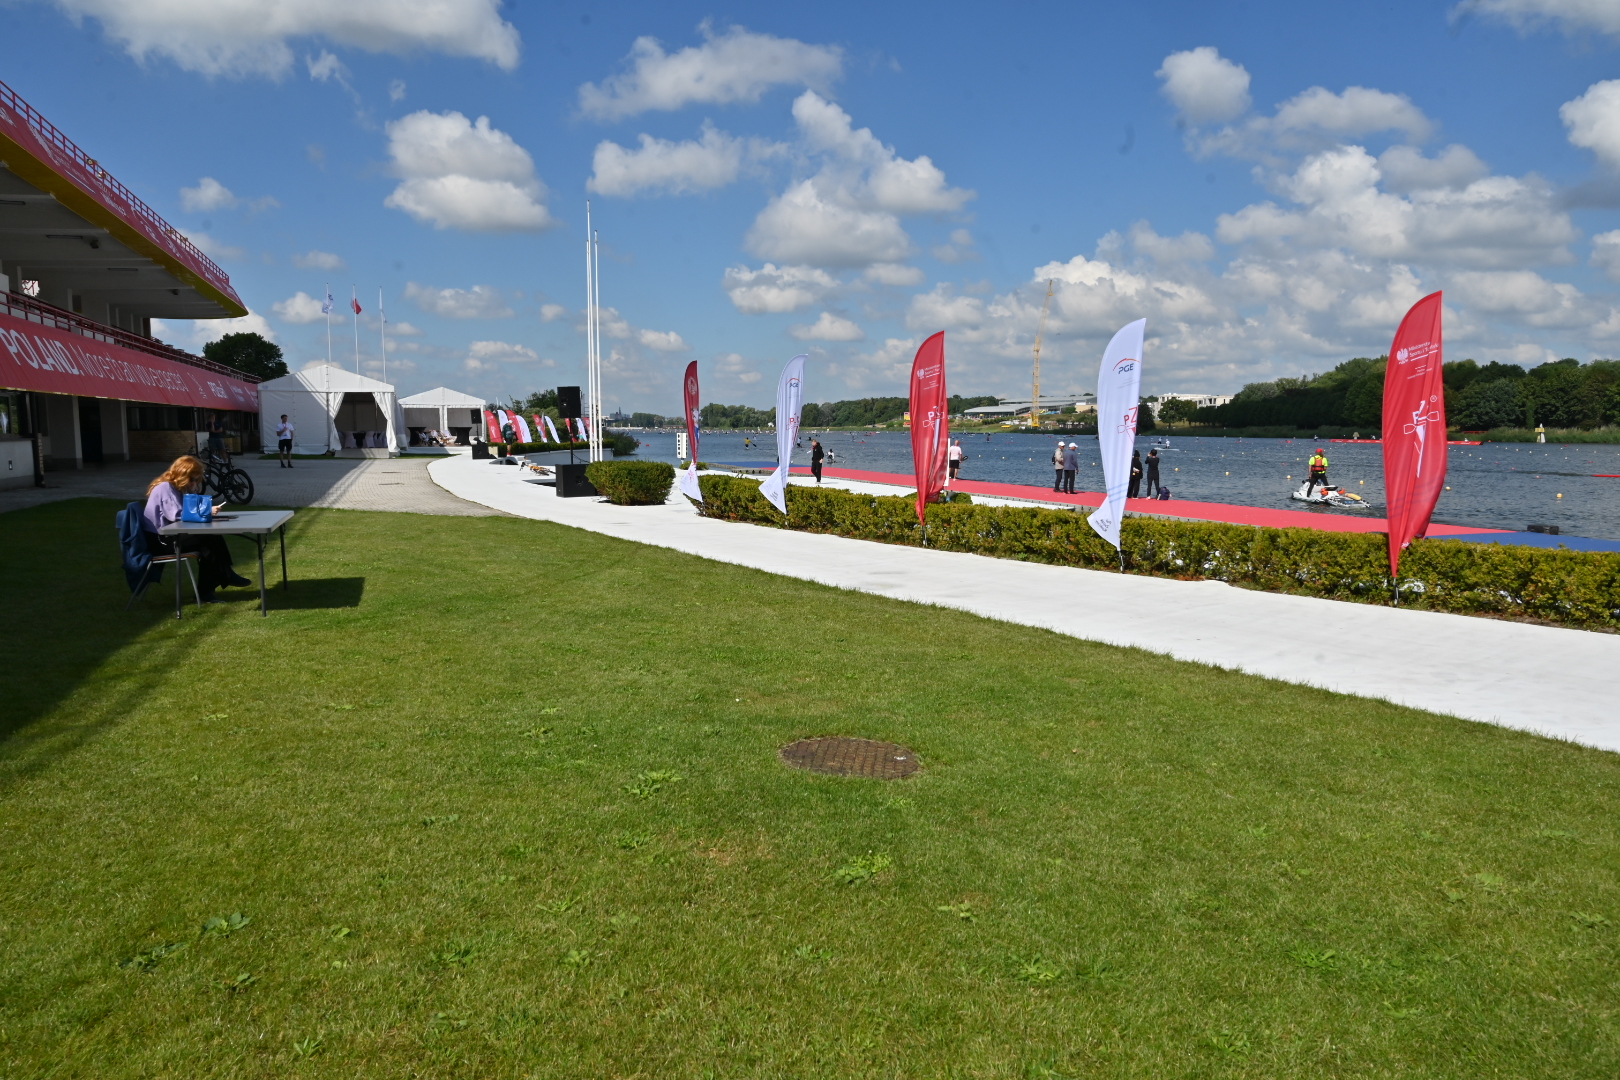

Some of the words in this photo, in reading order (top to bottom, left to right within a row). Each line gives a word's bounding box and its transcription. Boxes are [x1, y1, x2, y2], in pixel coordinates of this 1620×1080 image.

[0, 328, 85, 376] POLAND.
[68, 342, 114, 380] More
[103, 352, 139, 382] than
[1118, 363, 1134, 375] PGE
